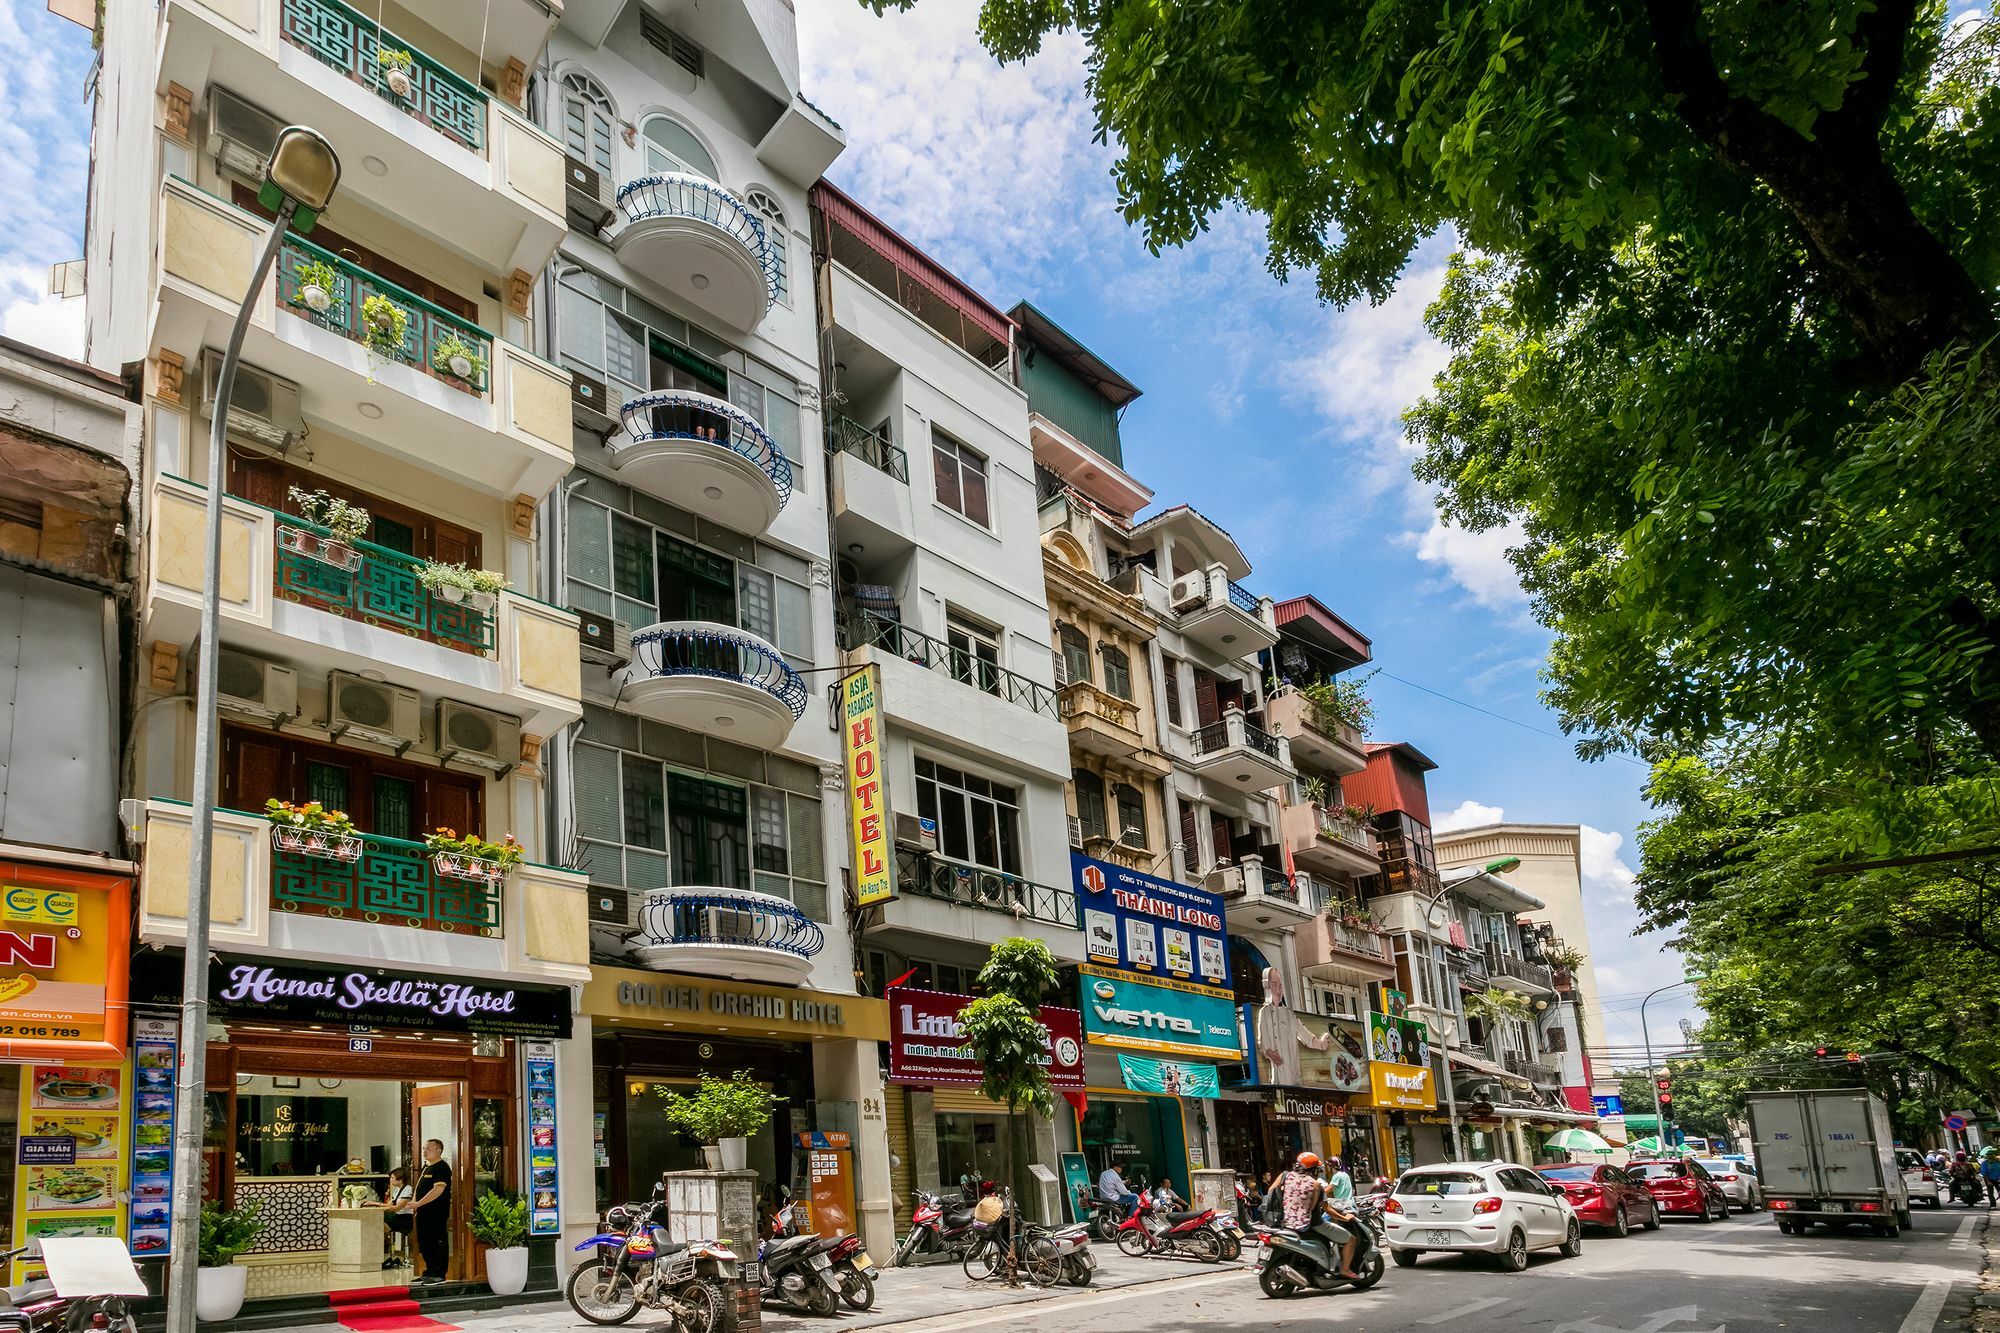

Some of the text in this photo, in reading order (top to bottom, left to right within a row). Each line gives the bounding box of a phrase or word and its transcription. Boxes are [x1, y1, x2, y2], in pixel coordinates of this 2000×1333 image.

[849, 674, 868, 698] ASIA
[847, 691, 874, 719] PARADISE
[852, 716, 883, 877] HOTEL
[860, 878, 888, 897] 34 Hang Tre
[13, 896, 38, 905] QUACERT
[51, 900, 75, 909] QUACERT
[1112, 888, 1222, 931] THÀNH LONG
[220, 965, 515, 1017] Hanoi Stella Hotel
[617, 980, 847, 1026] GOLDEN ORCHID HOTEL
[314, 1009, 342, 1019] Home
[357, 1012, 383, 1022] where
[386, 1014, 400, 1023] the
[402, 1015, 424, 1025] heart
[900, 1004, 968, 1039] Little
[20, 1026, 47, 1036] 016
[52, 1027, 80, 1037] 789
[1208, 1024, 1232, 1036] Telecom
[353, 1040, 368, 1051] 36
[904, 1043, 938, 1057] Indian,
[864, 1097, 880, 1113] 34
[1286, 1098, 1347, 1117] Master Chef
[303, 1121, 329, 1137] Hotel
[747, 1263, 758, 1271] BNE
